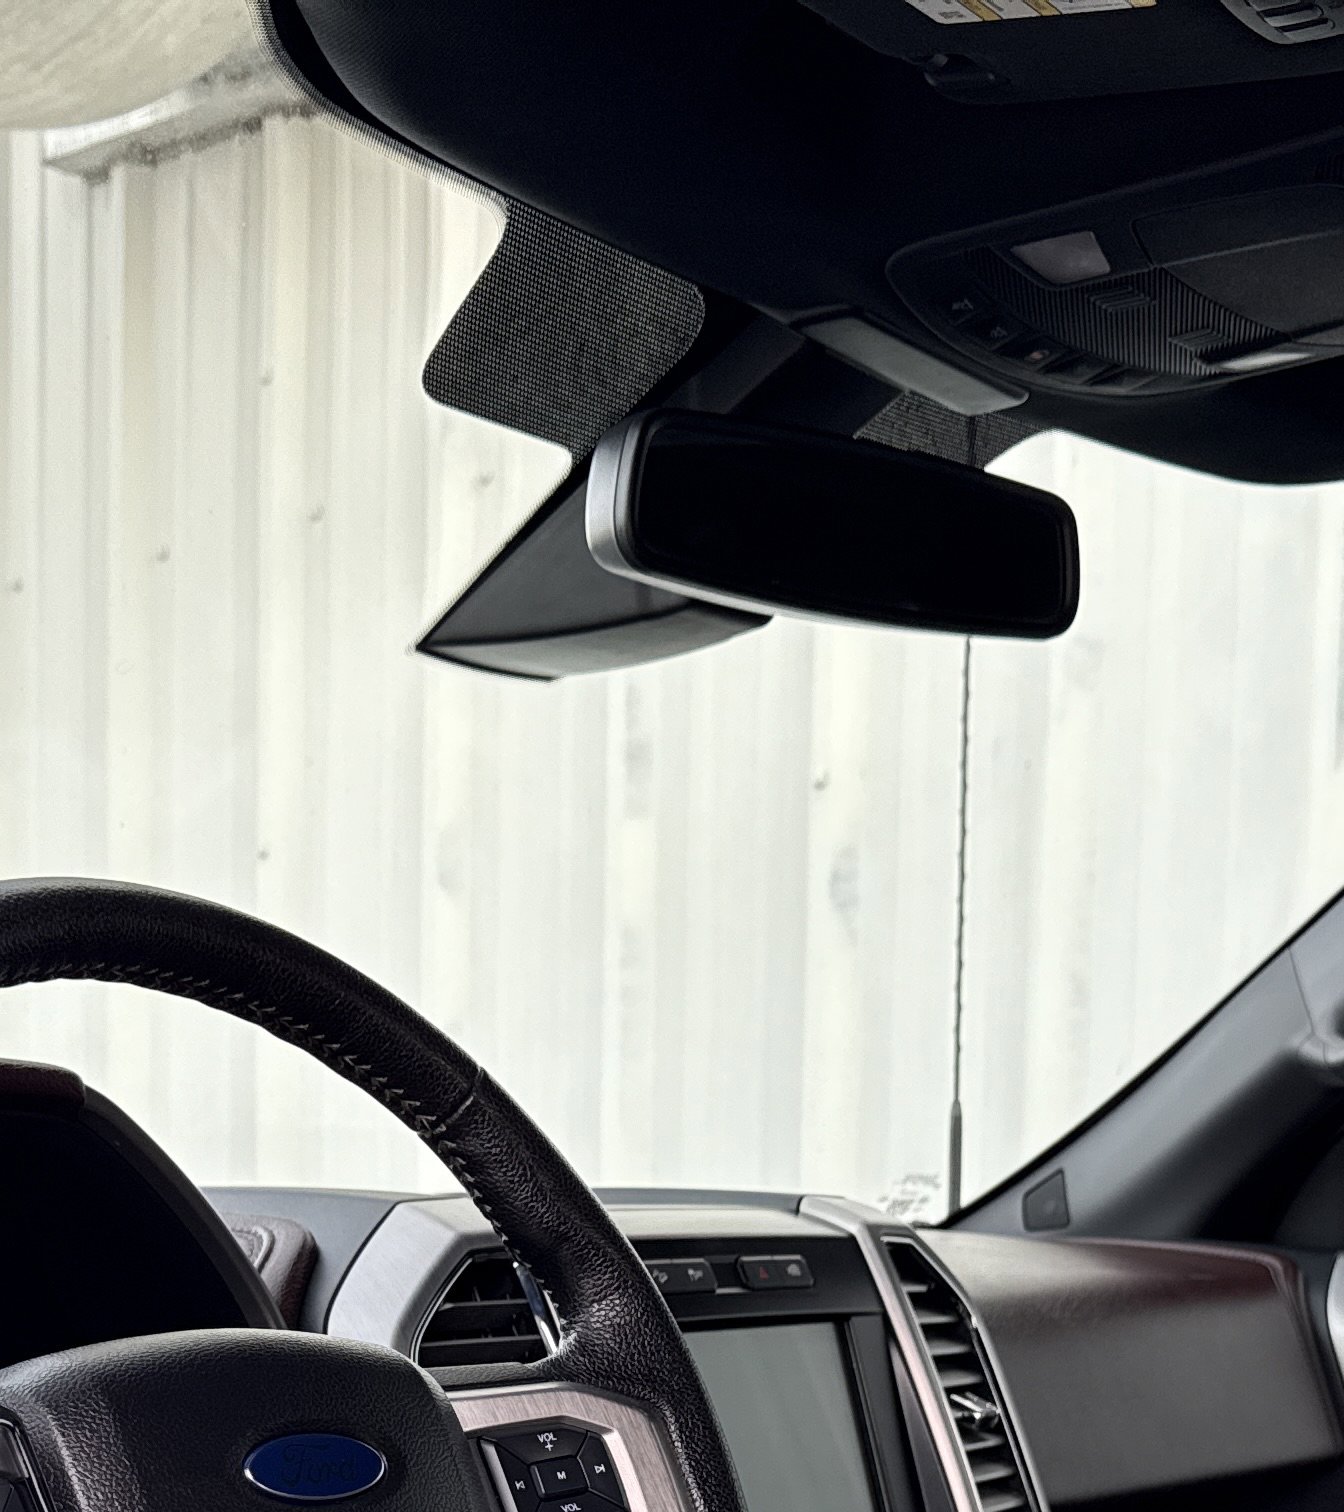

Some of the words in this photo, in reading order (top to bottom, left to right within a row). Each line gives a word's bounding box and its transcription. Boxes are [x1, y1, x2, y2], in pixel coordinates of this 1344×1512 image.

[537, 1432, 557, 1443] VOL
[280, 1443, 357, 1488] Ford
[556, 1470, 567, 1480] M
[560, 1502, 582, 1512] VOL
